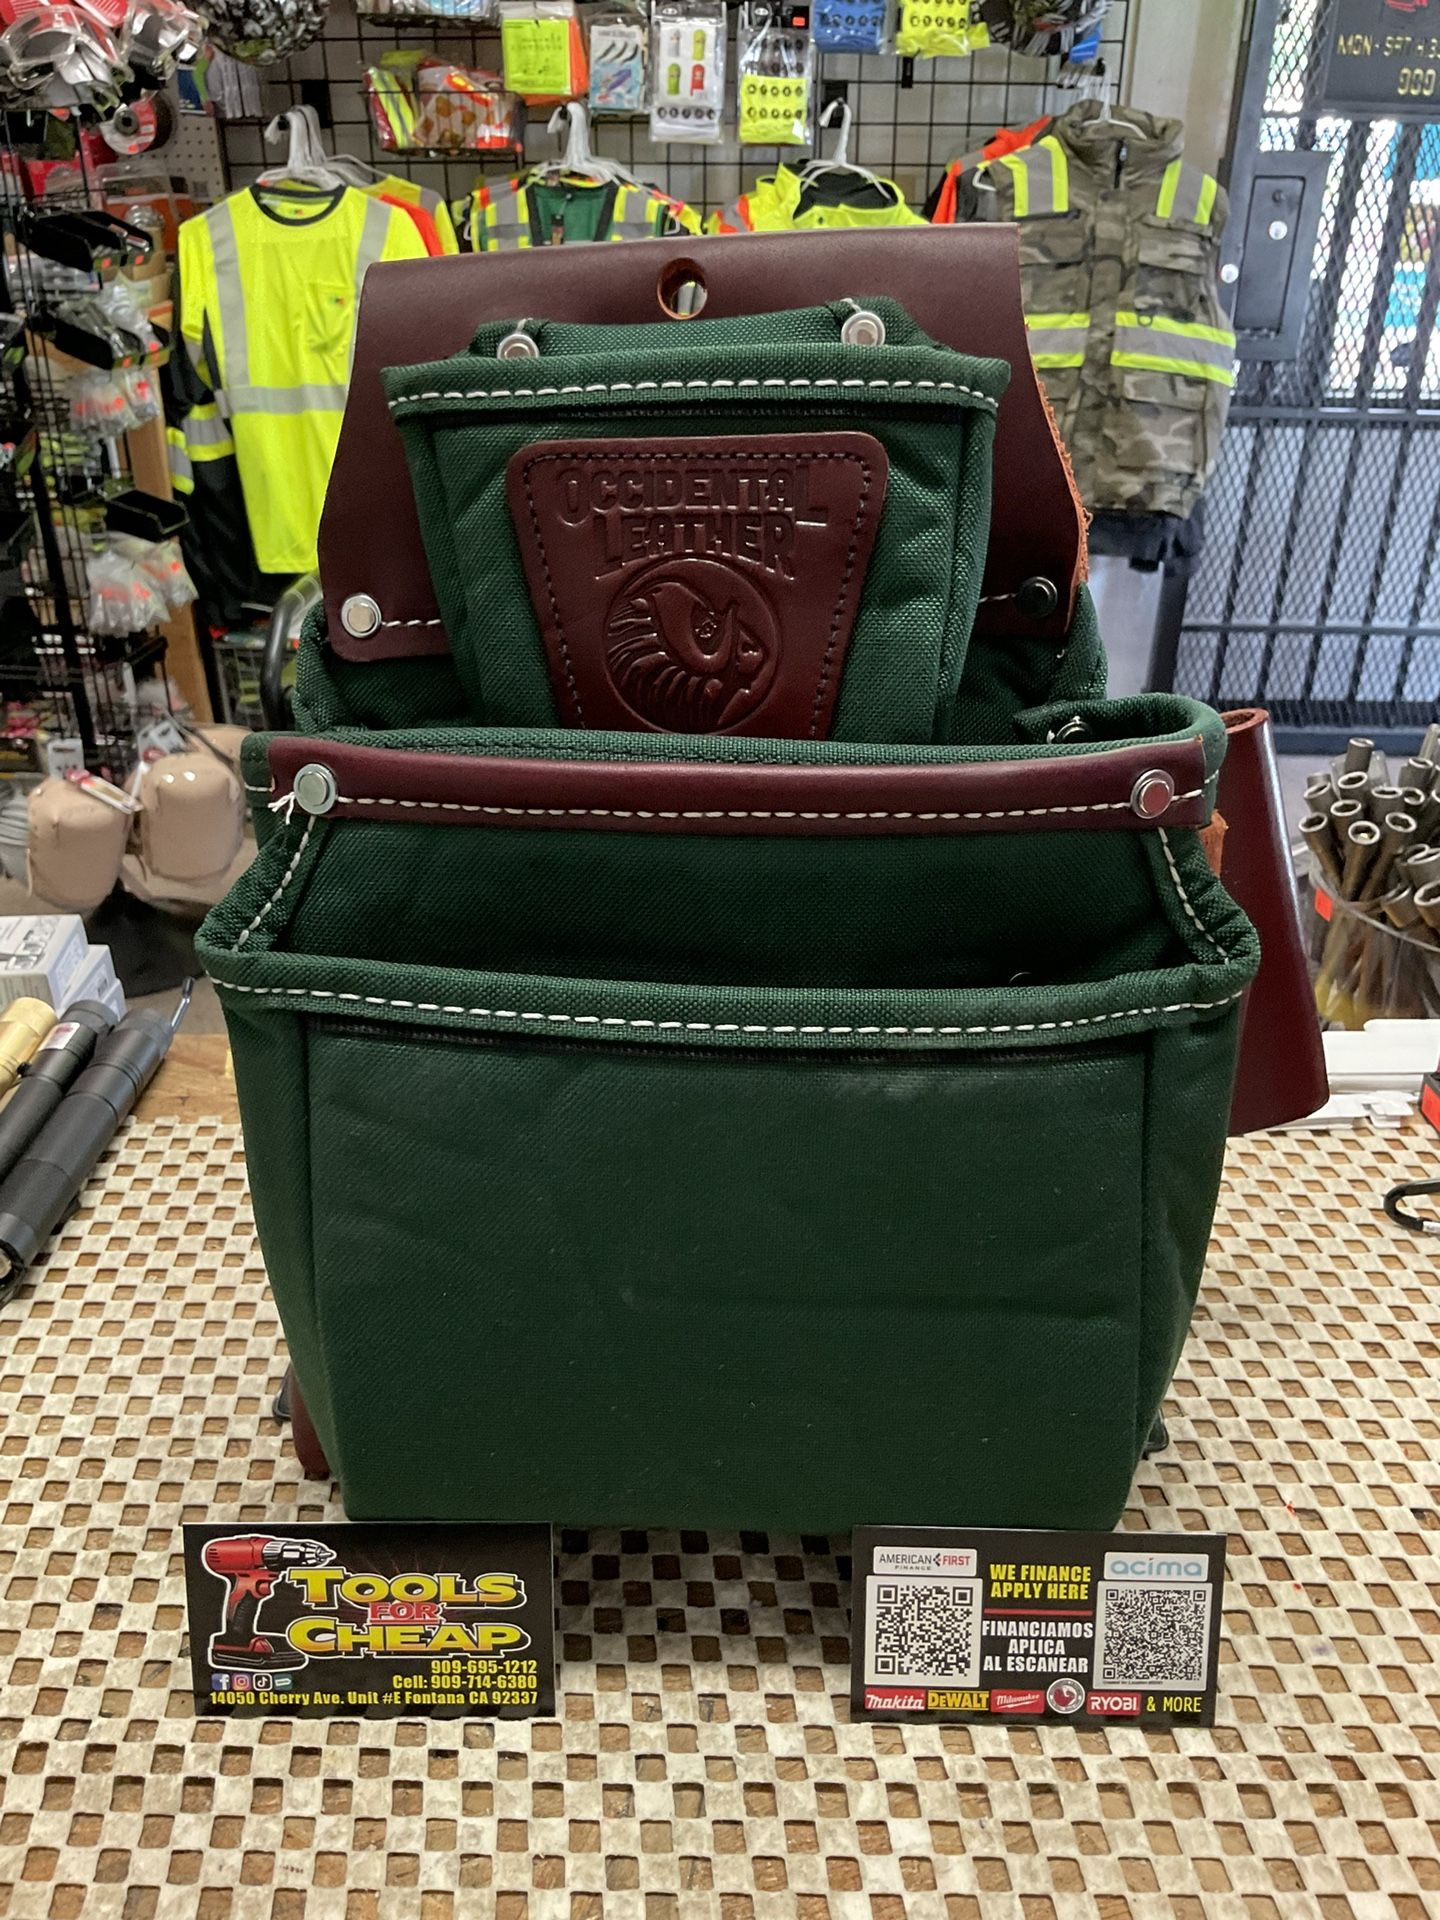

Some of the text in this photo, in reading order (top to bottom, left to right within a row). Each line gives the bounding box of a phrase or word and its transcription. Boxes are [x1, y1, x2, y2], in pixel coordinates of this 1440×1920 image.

[556, 466, 828, 528] OCCIDENTAL
[594, 510, 795, 581] LEATHER
[879, 1553, 970, 1566] AMERICAN FIRST
[1110, 1556, 1203, 1577] acima
[989, 1564, 1092, 1582] WE FINANCE
[288, 1568, 519, 1604] TOOLS
[990, 1582, 1089, 1600] APPLY HERE
[369, 1601, 439, 1621] FOR
[288, 1617, 522, 1653] CHEAP
[981, 1621, 1094, 1639] FINANCIAMOS
[1008, 1639, 1066, 1655] APLICA
[431, 1660, 538, 1674] 909-695-1212
[983, 1656, 1089, 1674] AL ESCANEAR
[392, 1675, 538, 1689] Cell: 909-714-6380
[210, 1691, 538, 1706] 14050 Cherry Ave. Unit #E Fontana CA 92337
[1090, 1696, 1138, 1711] RYOBI
[1146, 1696, 1203, 1713] & MORE
